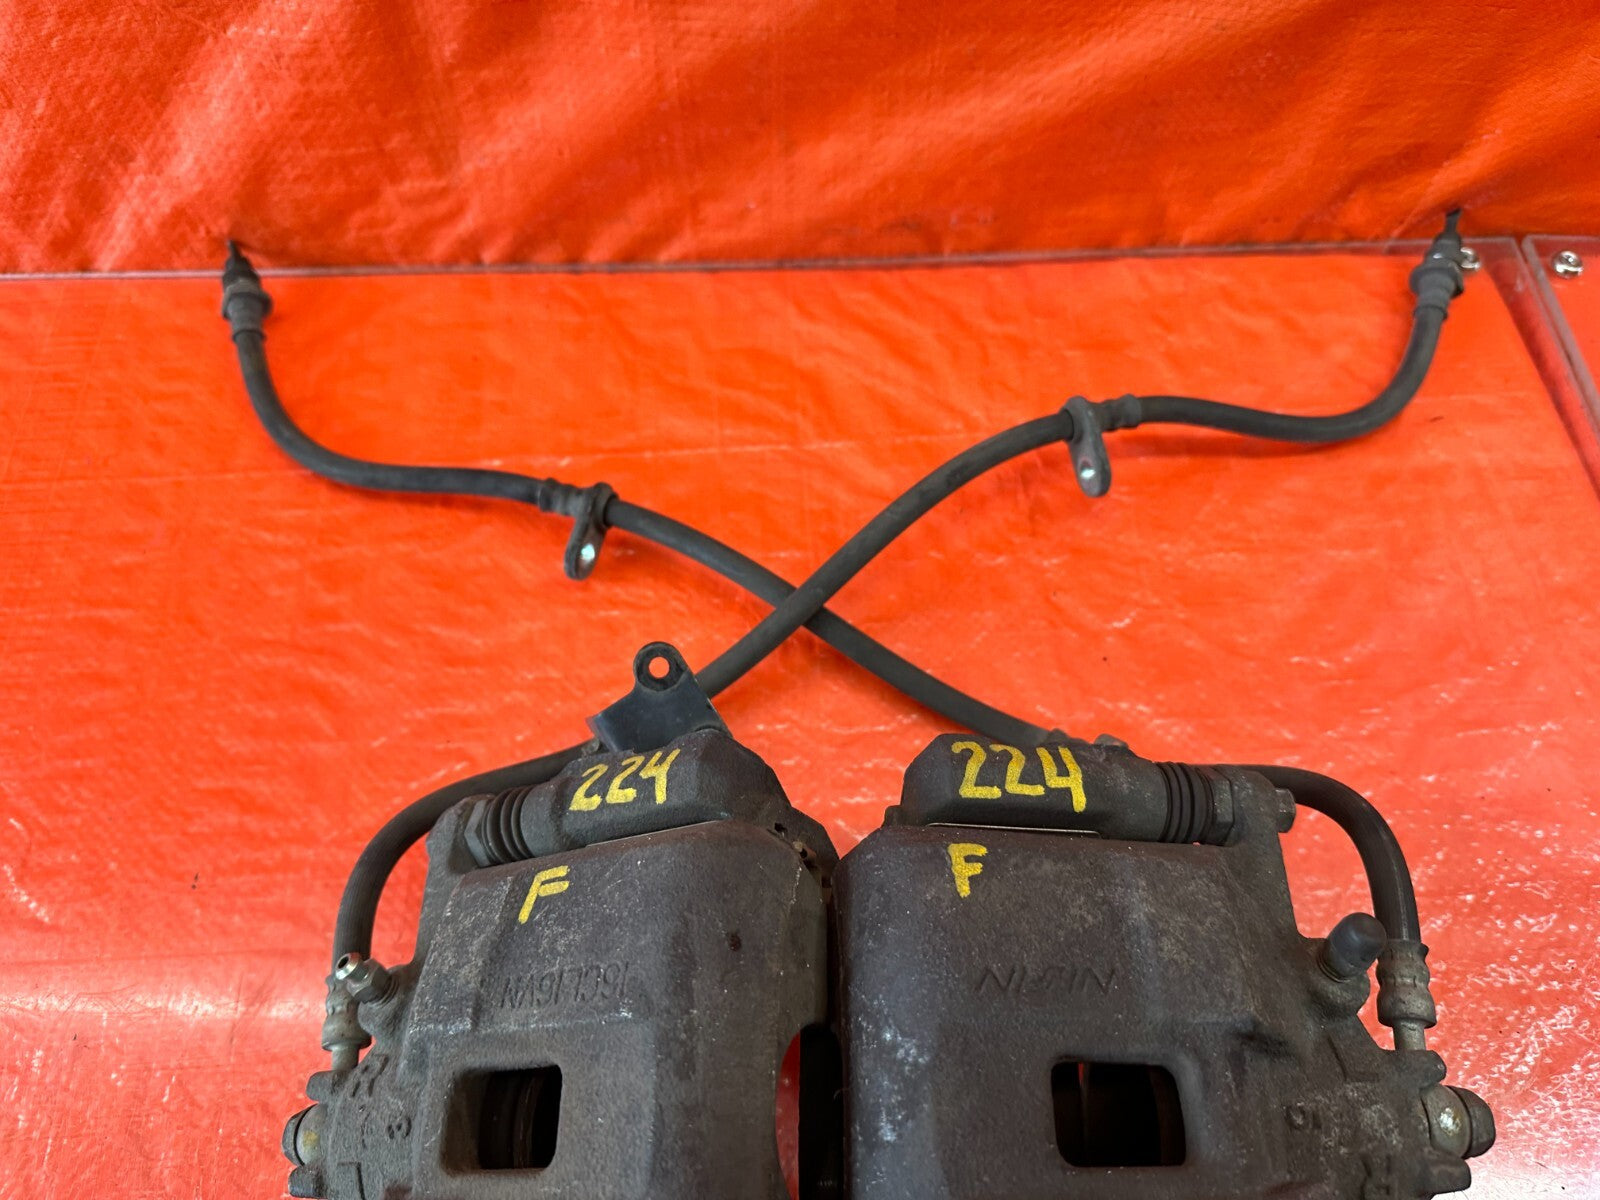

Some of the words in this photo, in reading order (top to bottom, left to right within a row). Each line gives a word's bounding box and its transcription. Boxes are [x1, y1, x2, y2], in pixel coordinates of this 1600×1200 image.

[568, 748, 681, 811] 224
[951, 741, 1087, 813] 224
[518, 865, 570, 924] F
[947, 843, 988, 898] F
